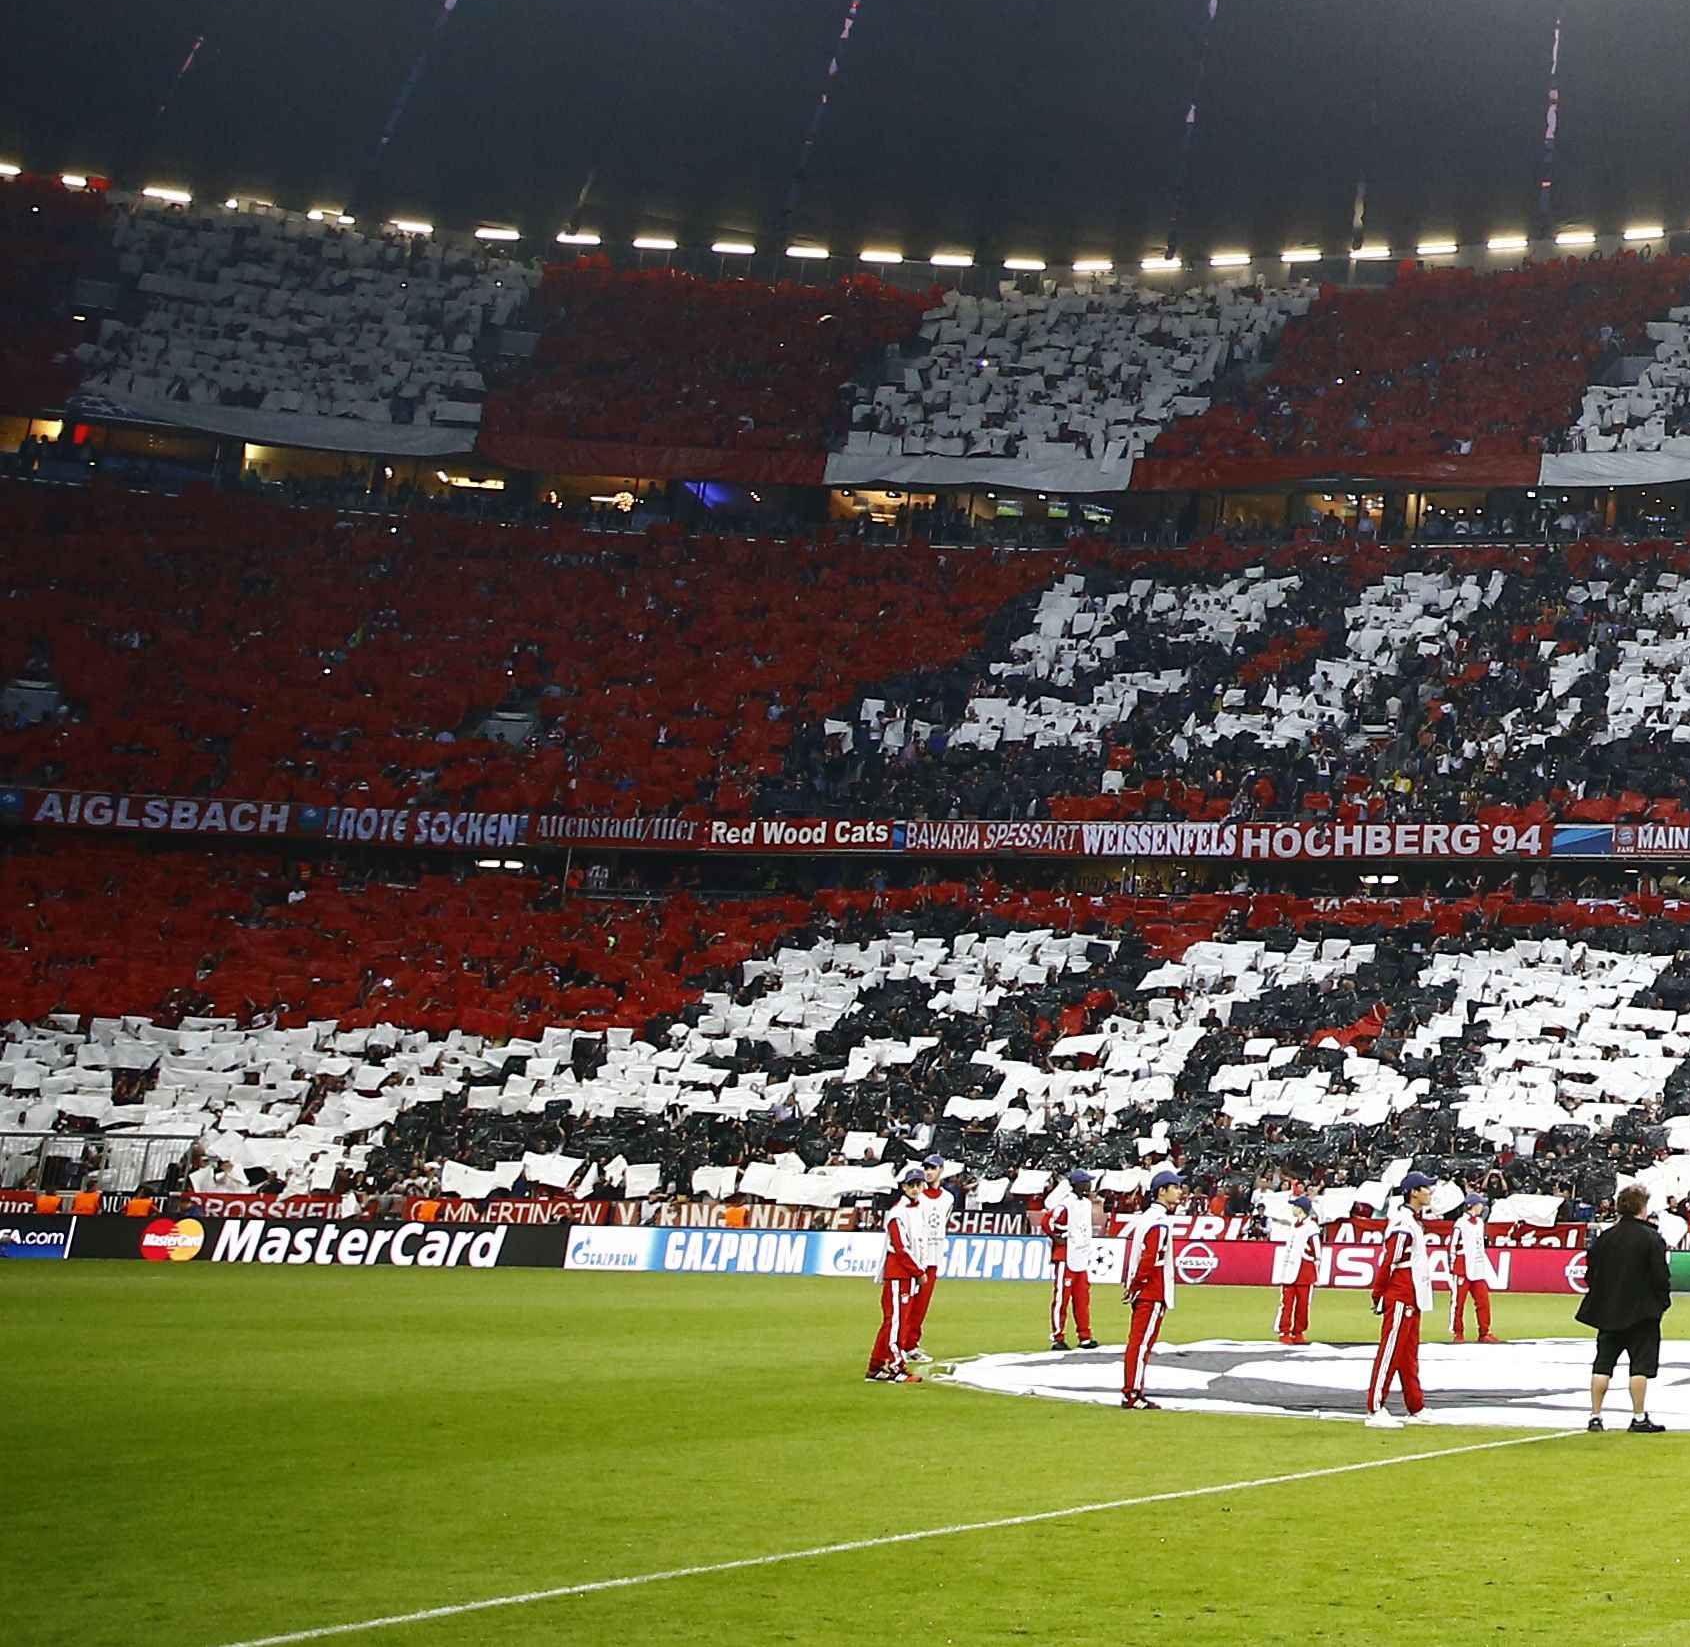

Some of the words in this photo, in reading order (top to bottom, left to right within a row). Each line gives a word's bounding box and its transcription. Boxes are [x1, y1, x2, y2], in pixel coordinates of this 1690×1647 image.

[33, 793, 290, 833] AIGLSBACH
[338, 808, 409, 842] ROTE
[413, 811, 519, 846] SOCKEN
[710, 820, 750, 845] Red
[762, 820, 826, 844] Wood
[834, 819, 889, 844] Cats
[906, 822, 978, 850] BAVARIA
[983, 823, 1079, 851] SPESSART
[1082, 822, 1238, 856] WEISSENFELS
[143, 1233, 203, 1248] MasterCard
[211, 1219, 507, 1268] MasterCard
[664, 1231, 808, 1274] GAZPROM
[589, 1253, 638, 1266] GAZPROM
[851, 1259, 878, 1271] GAZP
[1179, 1259, 1215, 1268] NISSAN
